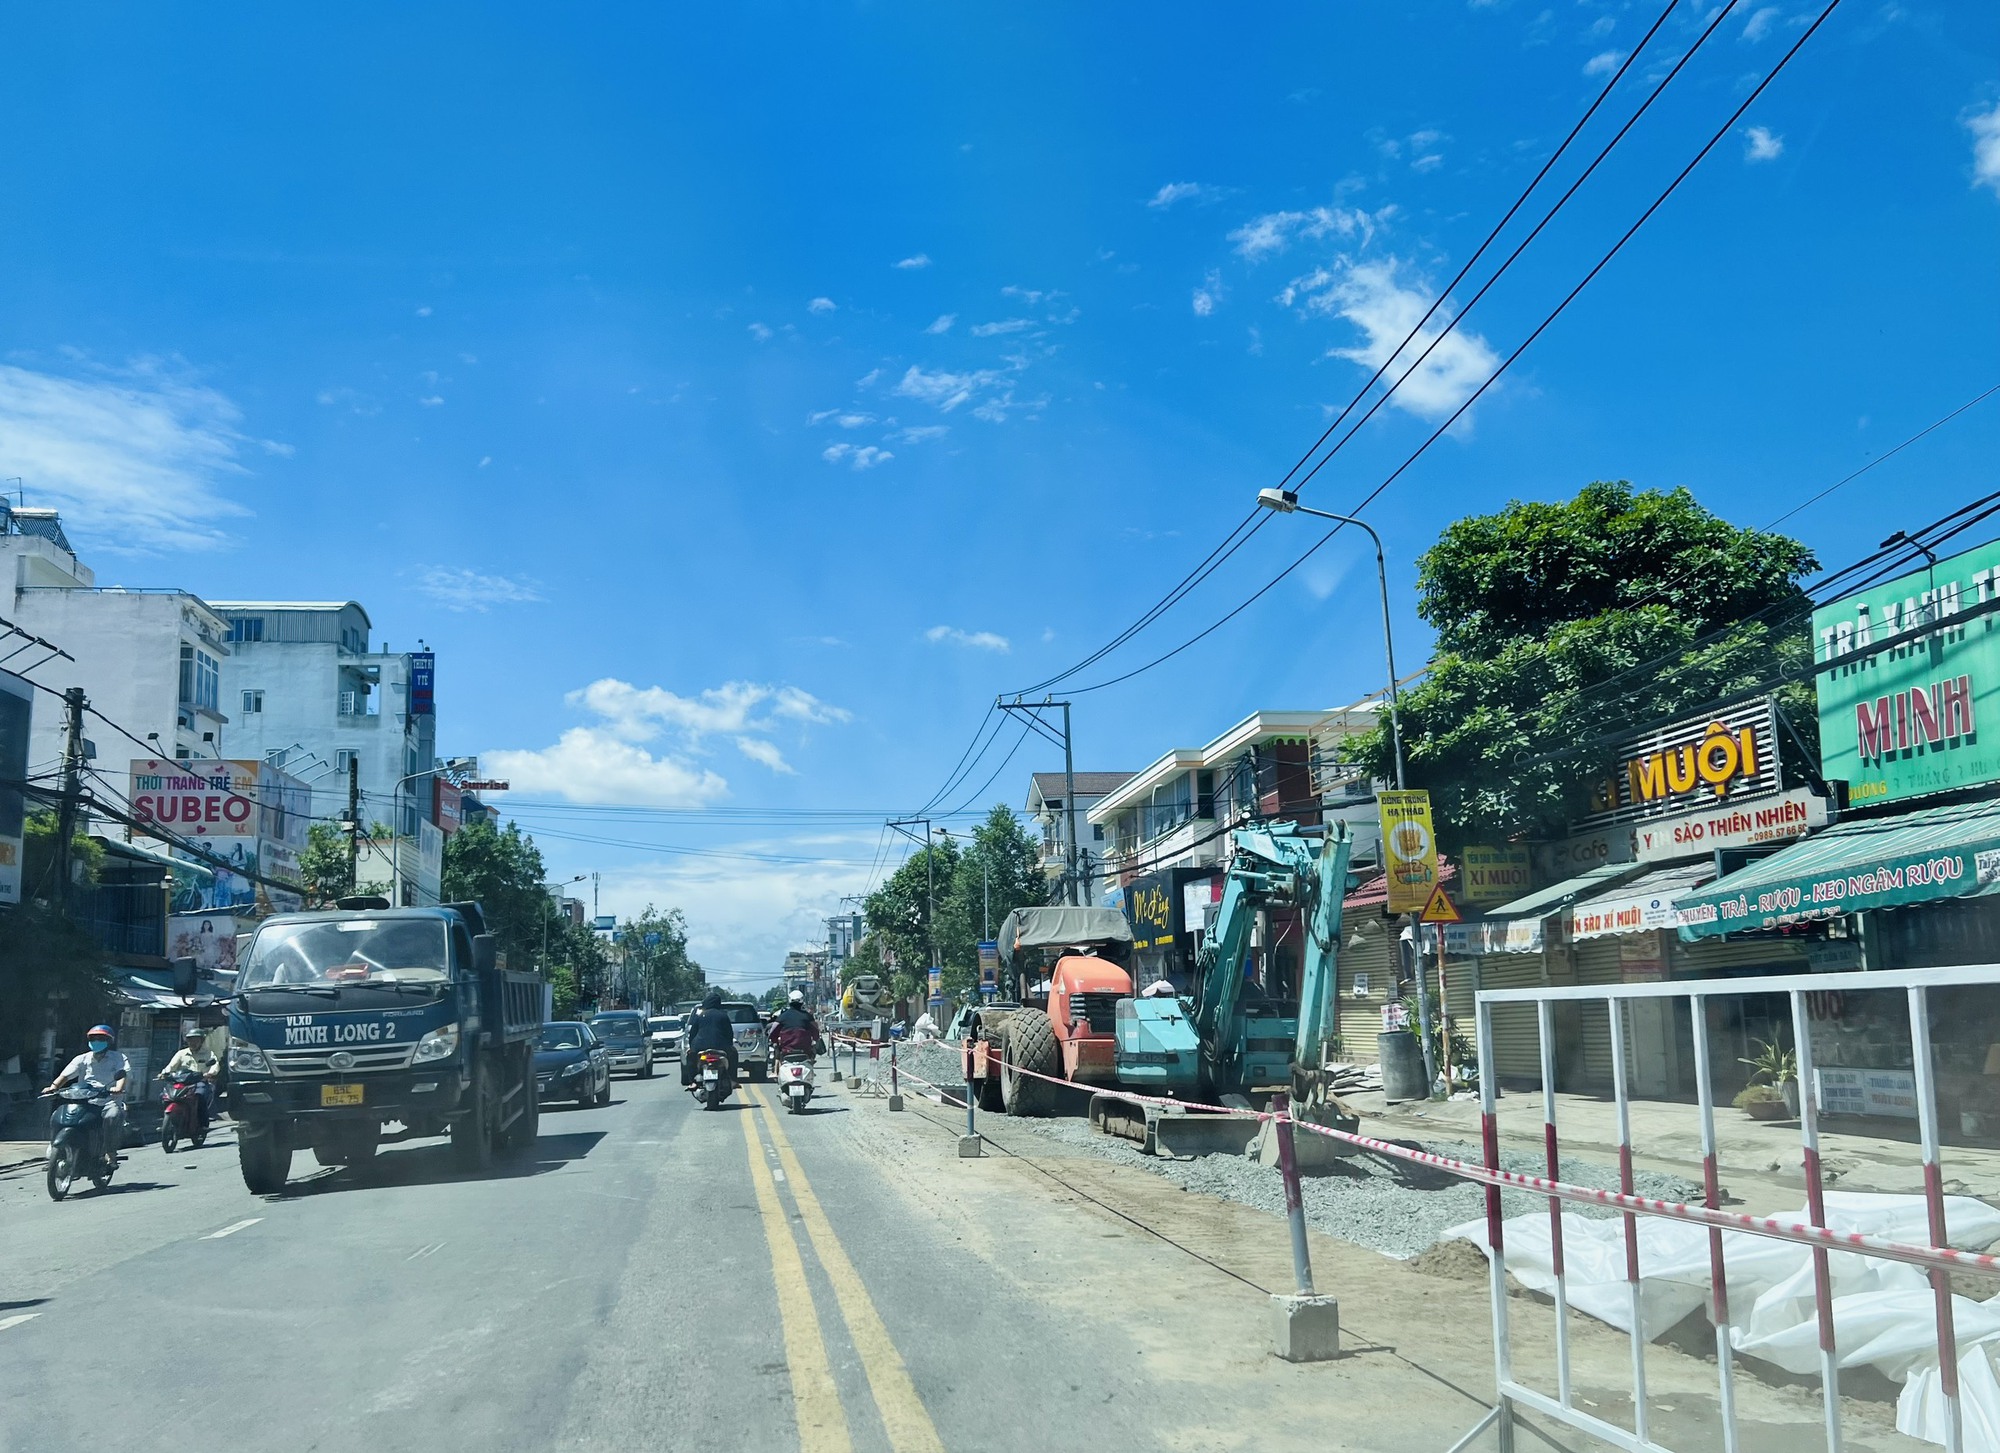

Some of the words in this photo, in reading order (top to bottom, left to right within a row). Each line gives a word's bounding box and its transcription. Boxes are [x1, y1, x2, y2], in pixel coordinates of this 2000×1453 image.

[1820, 602, 1873, 662] TRÀ
[1882, 580, 1965, 650] XANH
[1855, 673, 1976, 760] MINH
[1627, 720, 1760, 803] MUỘI
[135, 772, 162, 790] THỜI
[166, 776, 205, 790] TRANG
[209, 771, 231, 790] TRẺ
[234, 776, 253, 790] EM
[460, 780, 509, 790] Sunrise
[134, 795, 251, 823] SUBEO
[1674, 822, 1704, 844] SÀO
[1708, 811, 1752, 837] THIÊN
[1756, 801, 1807, 828] NHIÊN
[1470, 867, 1485, 886] XÍ
[1488, 865, 1528, 888] MUỘI
[1720, 894, 1748, 920] TRÀ
[1759, 887, 1801, 913] RƯỢU
[1813, 879, 1846, 903] KEO
[1848, 866, 1903, 896] NGÂM
[1906, 855, 1964, 887] RƯỢU
[1604, 908, 1614, 930] XÍ
[1616, 905, 1642, 929] MUỘI
[285, 1025, 328, 1045] MINH
[334, 1022, 381, 1042] LONG
[385, 1022, 396, 1039] 2
[286, 1015, 313, 1026] VLXD
